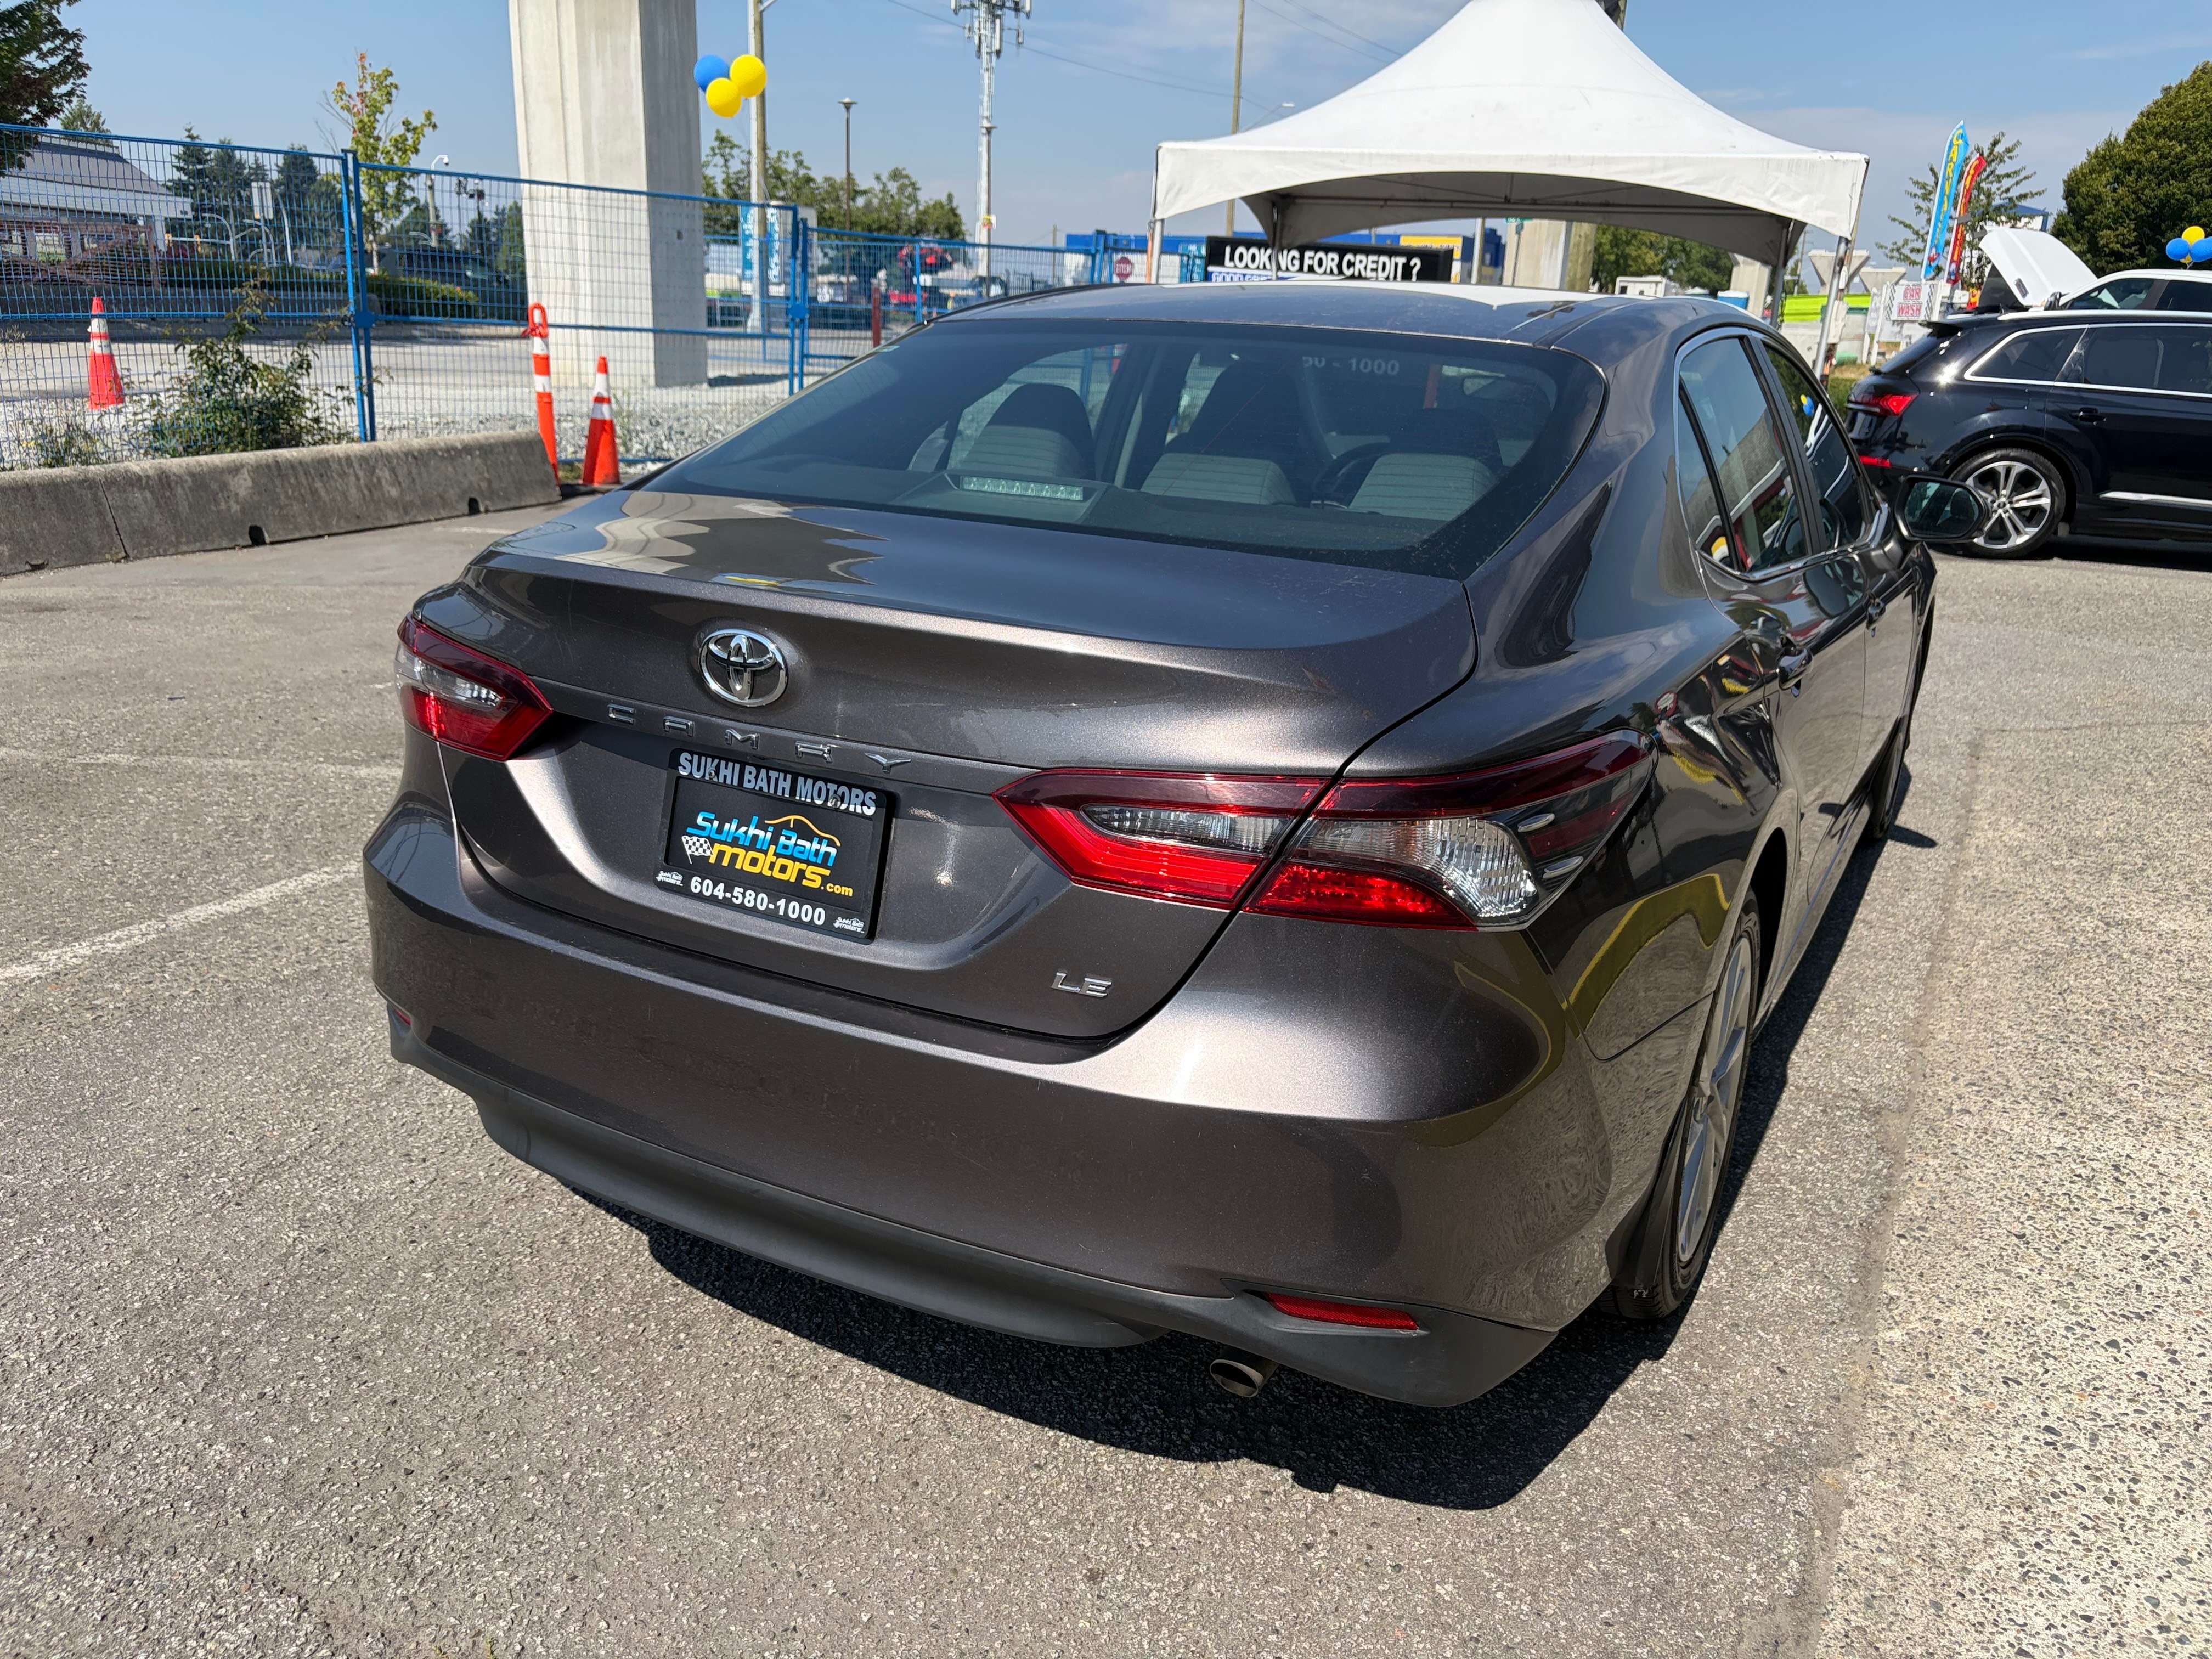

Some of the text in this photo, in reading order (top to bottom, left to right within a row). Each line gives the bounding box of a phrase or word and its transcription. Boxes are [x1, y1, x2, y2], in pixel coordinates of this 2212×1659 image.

[1224, 245, 1301, 273] LOOKNG
[1303, 250, 1340, 275] FOR
[1342, 252, 1407, 281] CREDIT
[1409, 256, 1421, 281] ?
[1897, 302, 1923, 317] WASH
[1903, 285, 1922, 300] CAR
[1348, 358, 1400, 375] 1000
[607, 704, 912, 773] CAMRY
[678, 752, 877, 816] SUKHI BATH MOTORS
[686, 811, 838, 867] Sukhi Bath
[690, 876, 826, 926] 604-580-1000
[1050, 971, 1112, 998] LE
